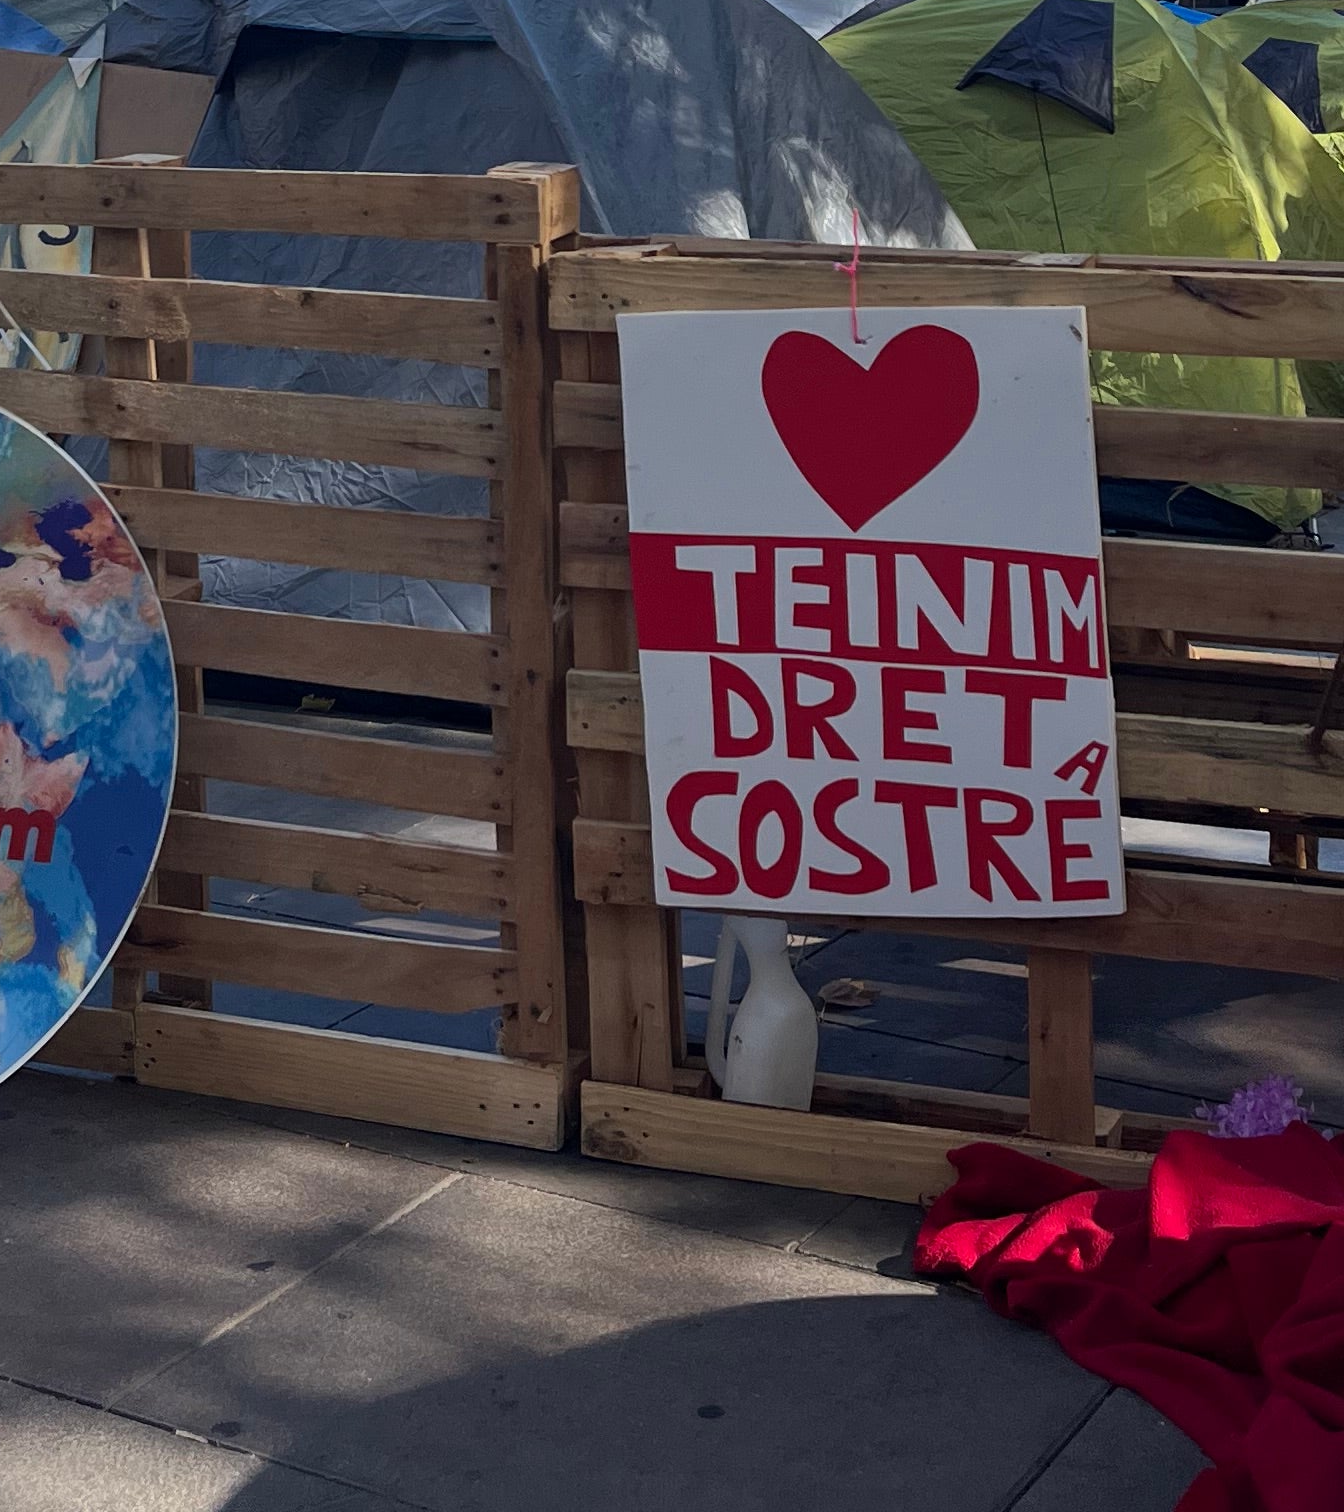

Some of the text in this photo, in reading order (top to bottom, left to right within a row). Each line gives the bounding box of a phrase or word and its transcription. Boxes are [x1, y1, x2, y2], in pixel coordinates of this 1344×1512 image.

[675, 545, 1099, 670] TEINIM
[709, 655, 1067, 768] DRET
[665, 771, 1110, 903] SOSTRE
